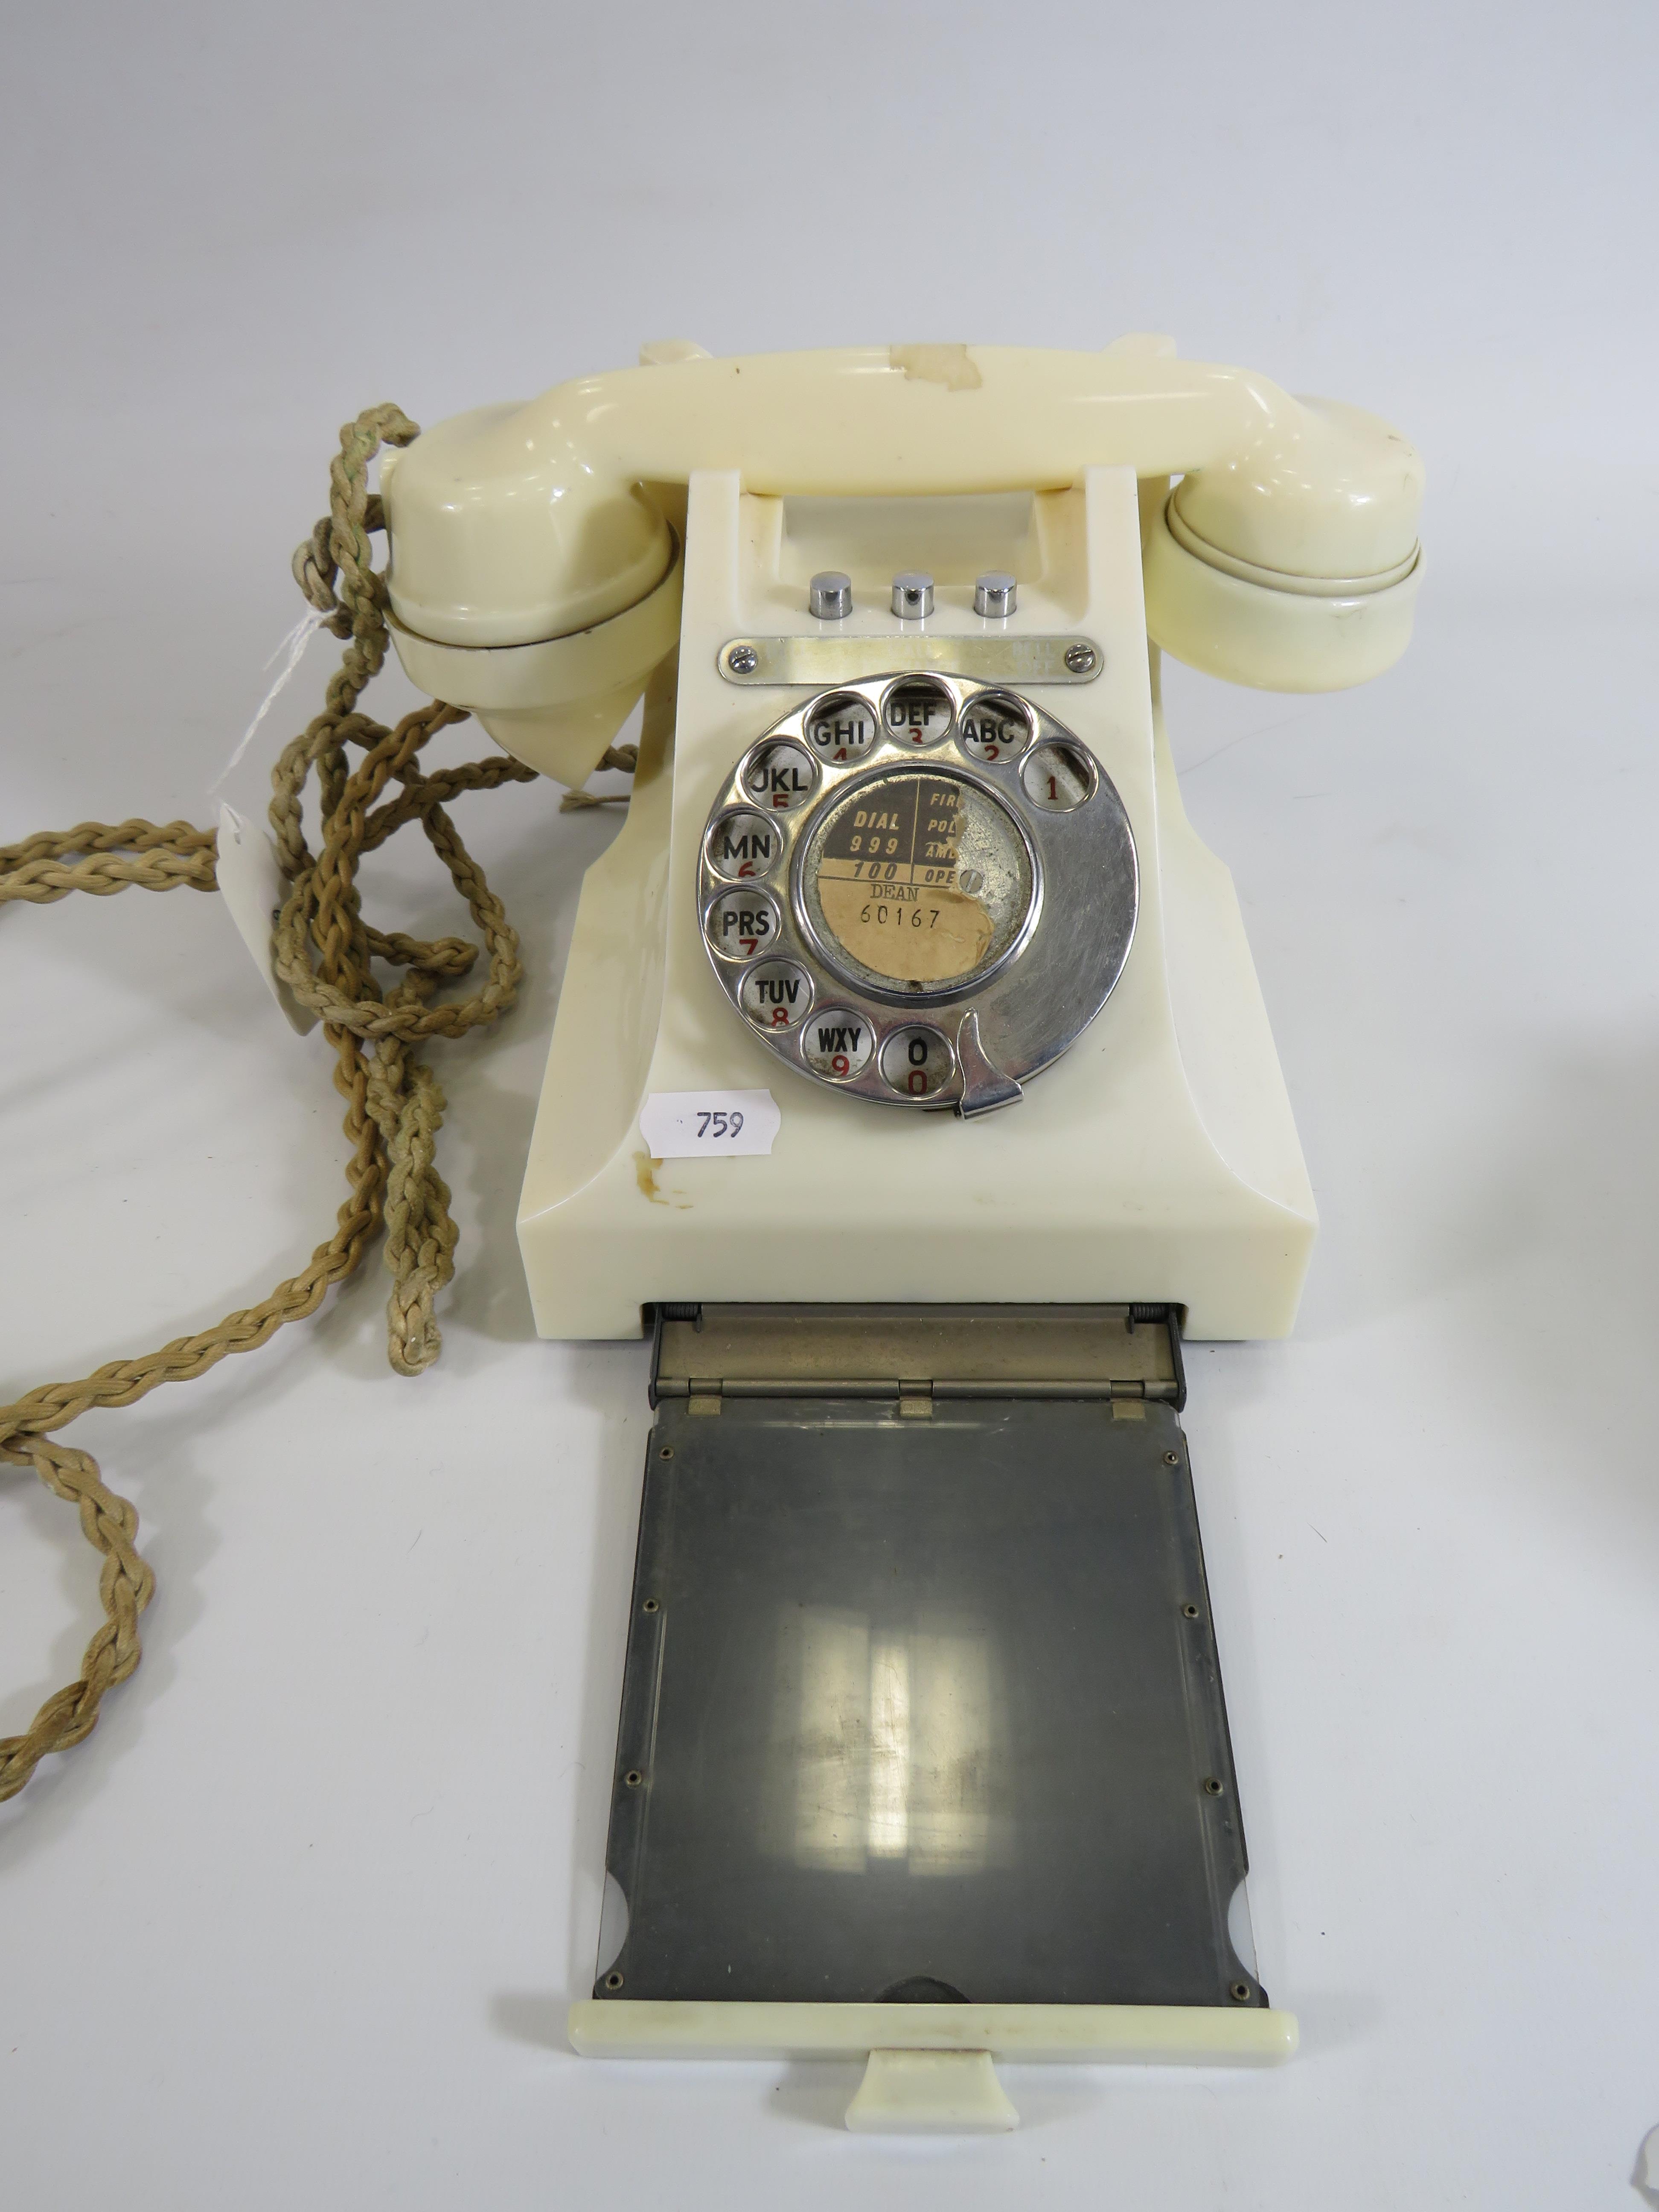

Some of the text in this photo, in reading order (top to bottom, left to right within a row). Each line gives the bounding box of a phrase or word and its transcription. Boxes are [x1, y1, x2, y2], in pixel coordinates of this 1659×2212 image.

[891, 701, 936, 726] DEF
[814, 721, 864, 746] GHI
[963, 719, 1014, 744] ABC
[751, 768, 808, 792] JKL
[1047, 776, 1058, 800] 1
[854, 810, 899, 830] DIAL
[723, 835, 770, 859] MN
[850, 835, 898, 854] 999
[854, 861, 897, 880] 100
[870, 883, 920, 902] DEAN
[723, 910, 769, 936] PRS
[861, 904, 940, 928] 60167
[755, 978, 801, 1004] TUV
[818, 1027, 861, 1052] WXY
[832, 1055, 850, 1077] 9
[697, 1112, 744, 1138] 759
